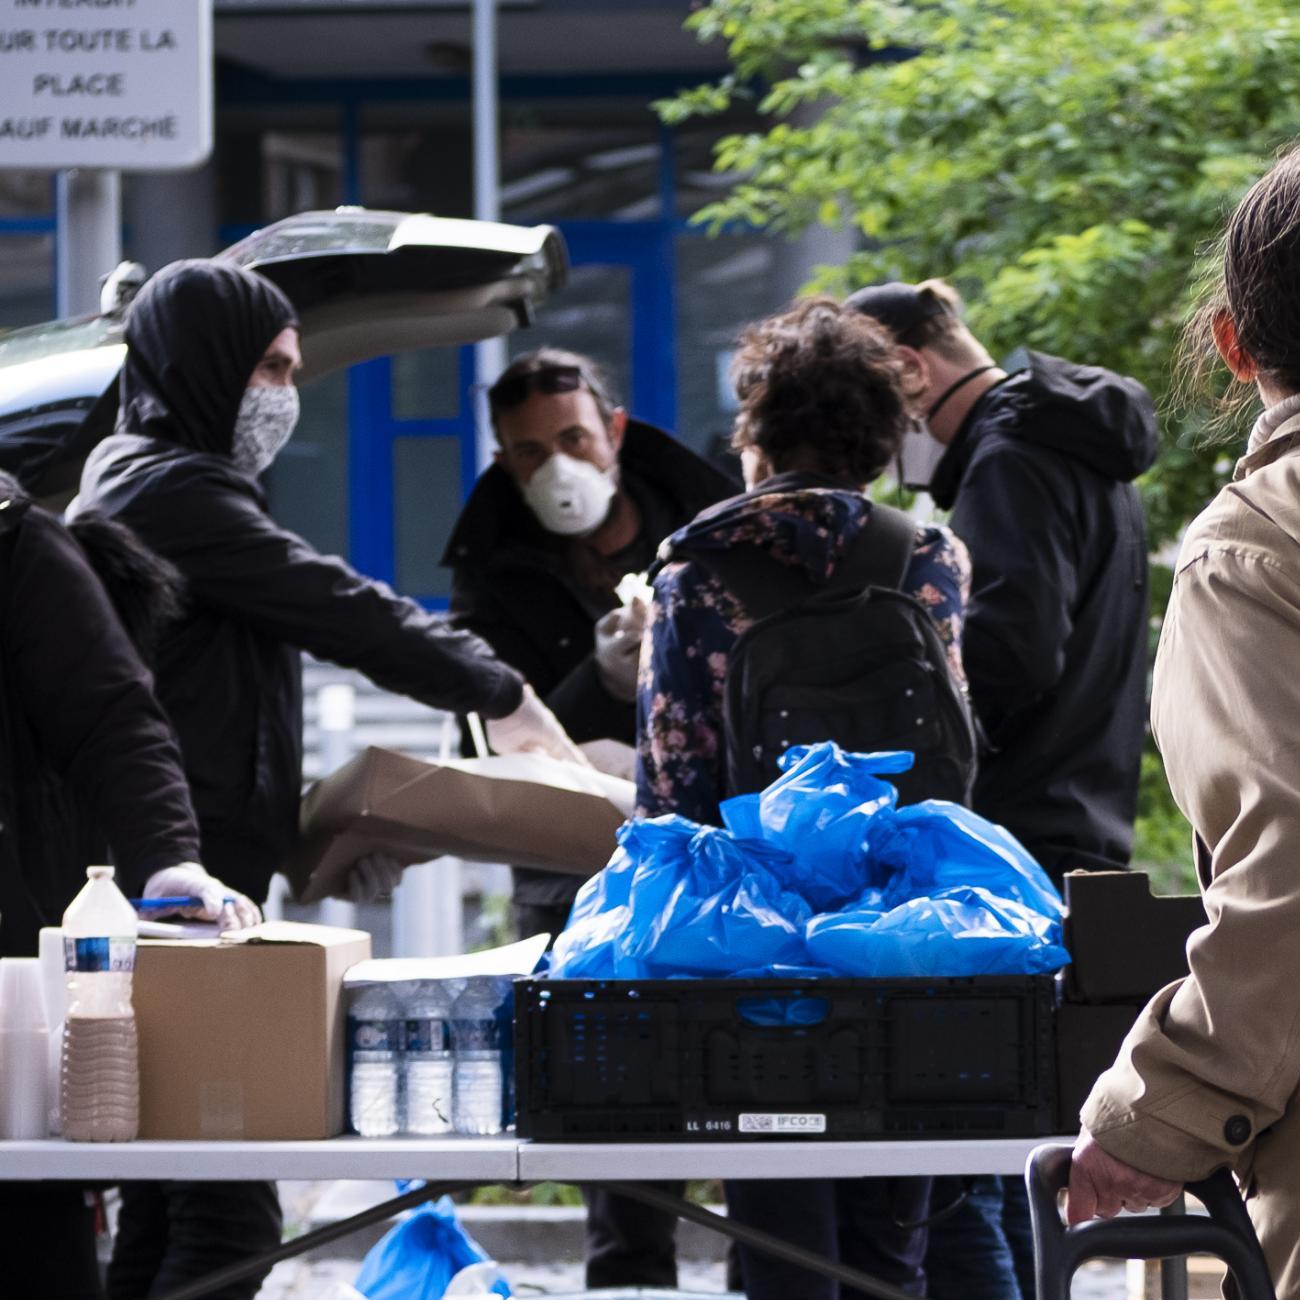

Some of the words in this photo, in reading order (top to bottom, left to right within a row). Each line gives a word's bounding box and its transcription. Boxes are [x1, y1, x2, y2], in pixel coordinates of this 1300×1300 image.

[45, 29, 132, 52] TOUTE
[139, 29, 177, 51] LA
[33, 73, 123, 96] PLACE
